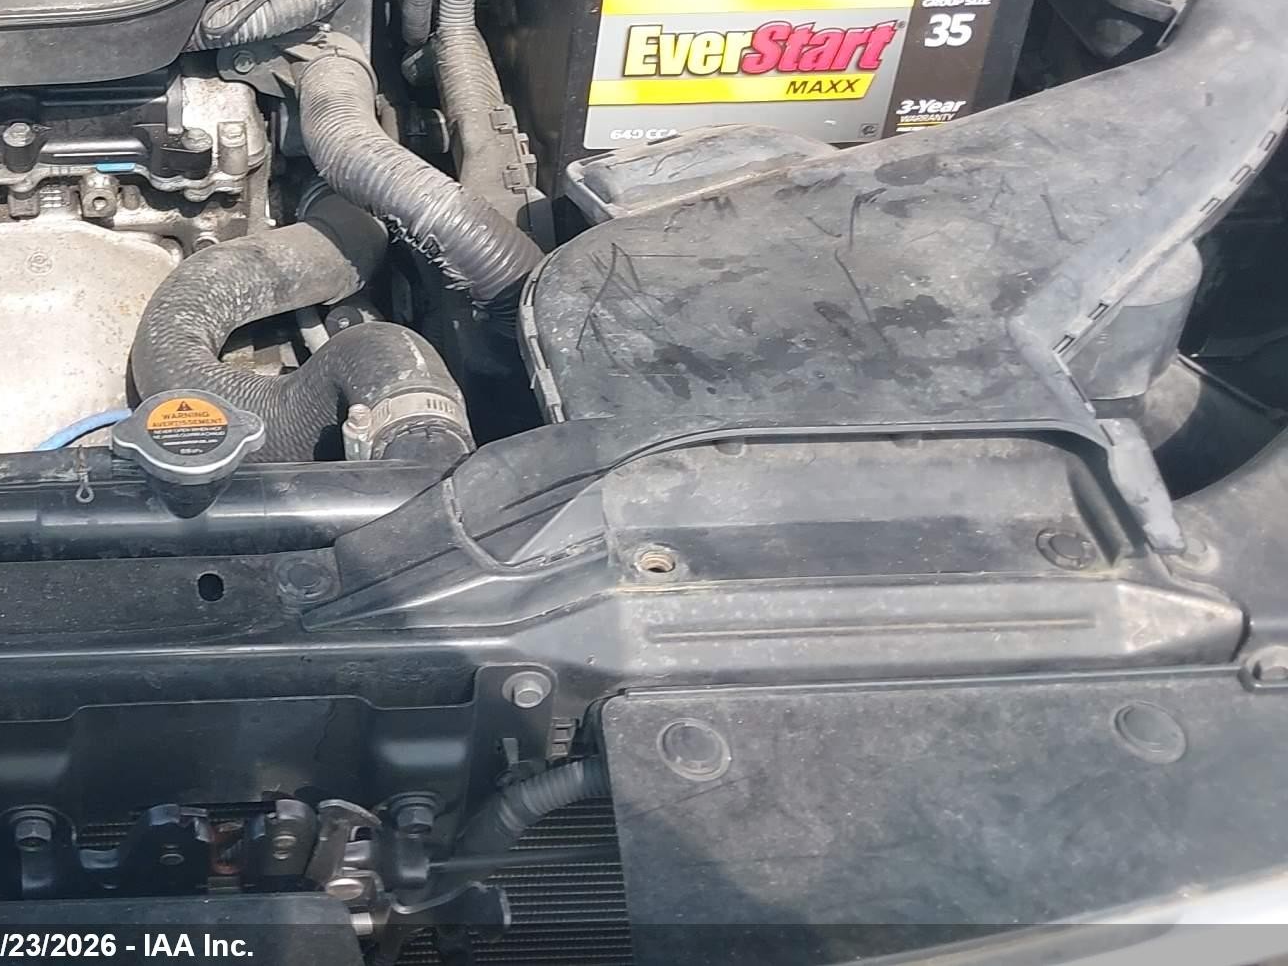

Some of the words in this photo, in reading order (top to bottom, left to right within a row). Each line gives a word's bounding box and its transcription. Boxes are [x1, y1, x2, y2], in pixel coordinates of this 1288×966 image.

[924, 12, 976, 47] 35
[623, 20, 898, 76] EverStart
[785, 78, 861, 95] MAXX
[896, 99, 966, 115] 3-Year
[900, 113, 956, 123] WARRANTY
[152, 418, 222, 427] AVERTISSEMENT
[161, 411, 210, 420] WARNING
